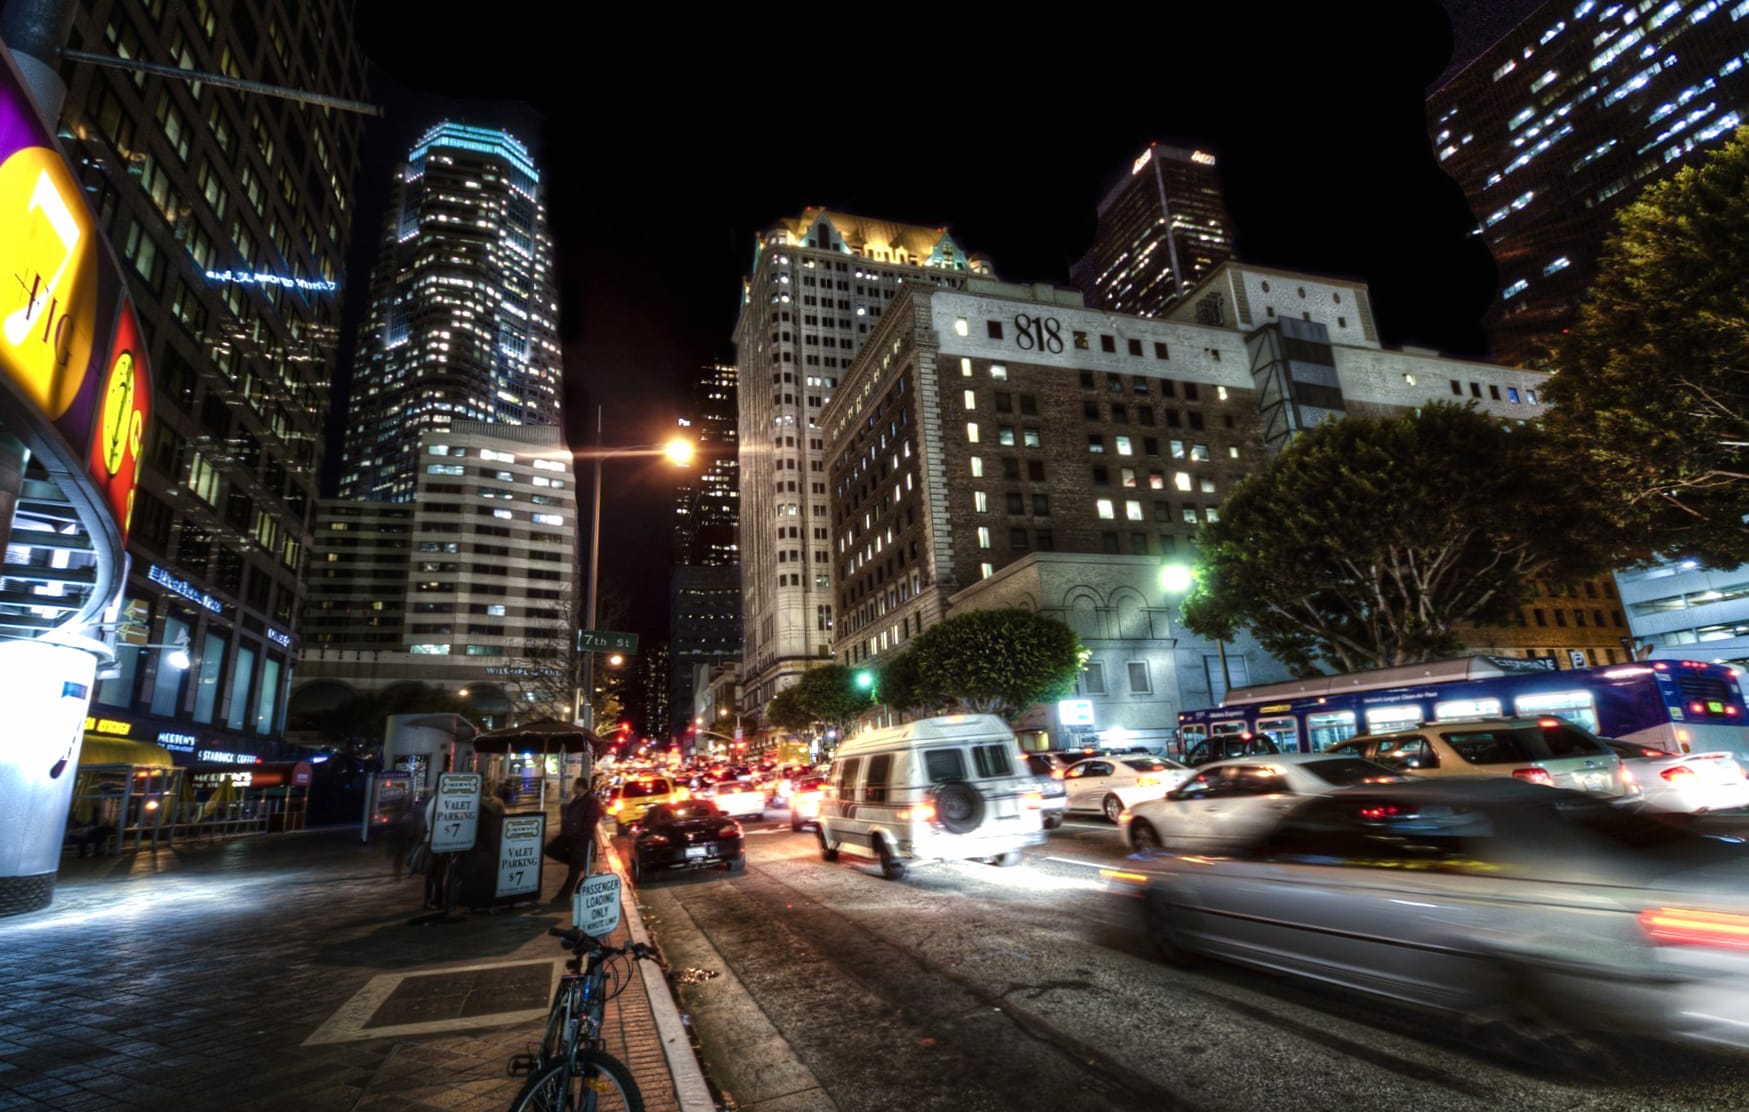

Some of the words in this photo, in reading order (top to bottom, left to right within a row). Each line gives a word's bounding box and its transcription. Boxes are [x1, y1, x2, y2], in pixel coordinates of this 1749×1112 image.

[1014, 313, 1064, 354] 818
[584, 634, 607, 646] 7th
[616, 637, 630, 648] St
[444, 800, 472, 811] VALET
[437, 811, 475, 822] PARKING
[444, 823, 461, 838] $7
[508, 847, 534, 858] VALET
[502, 858, 538, 870] PARKING
[508, 871, 525, 886] $7
[582, 879, 619, 896] PASSENGER
[586, 892, 615, 909] LOADING
[592, 906, 608, 920] ONLY
